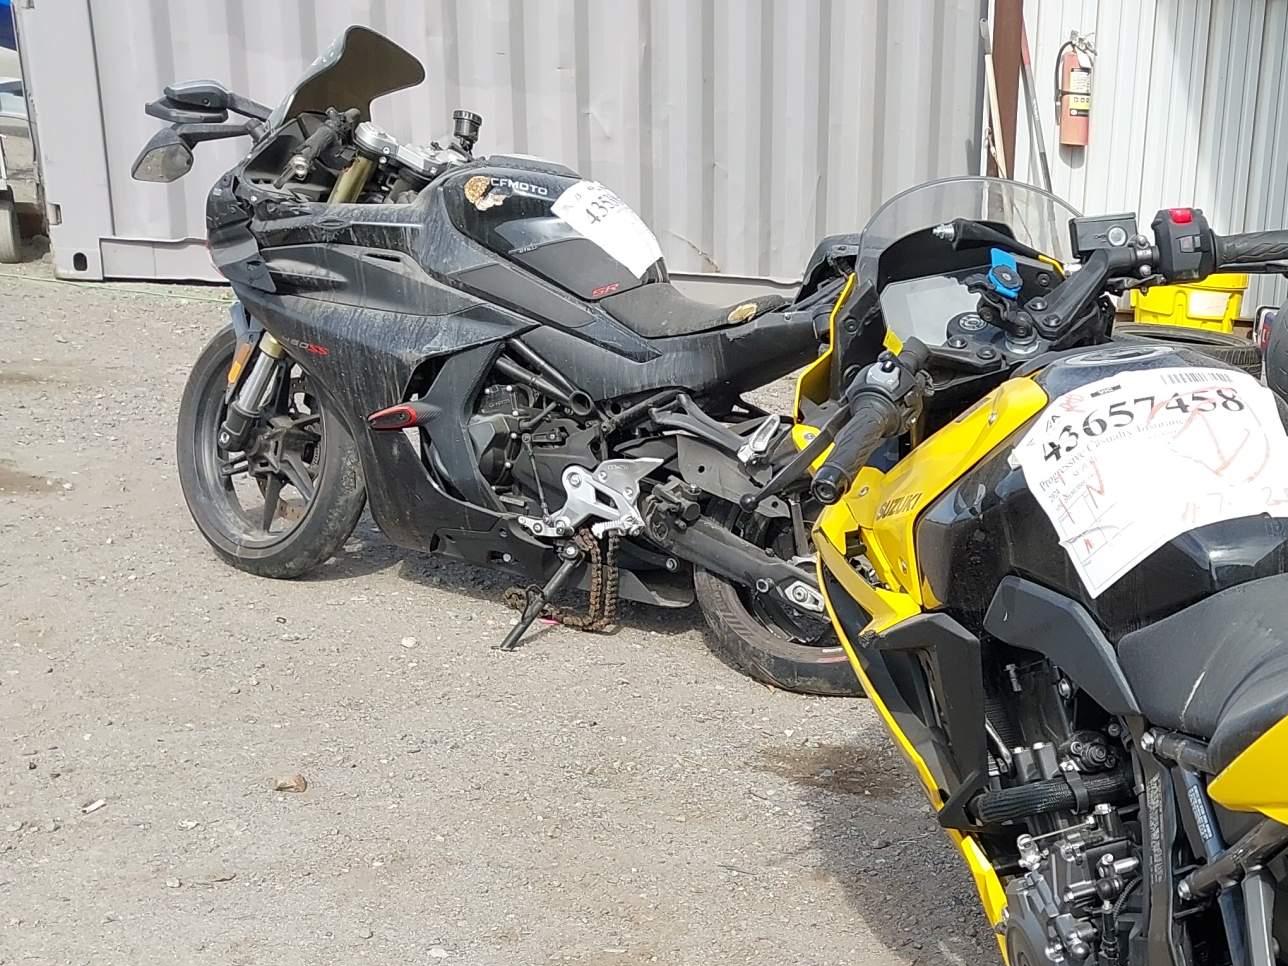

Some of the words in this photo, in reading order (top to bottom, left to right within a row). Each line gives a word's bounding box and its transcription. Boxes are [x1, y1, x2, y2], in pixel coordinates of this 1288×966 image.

[490, 177, 548, 196] CFMOTO
[1042, 388, 1245, 462] 43657458
[876, 492, 923, 521] SUZUKI
